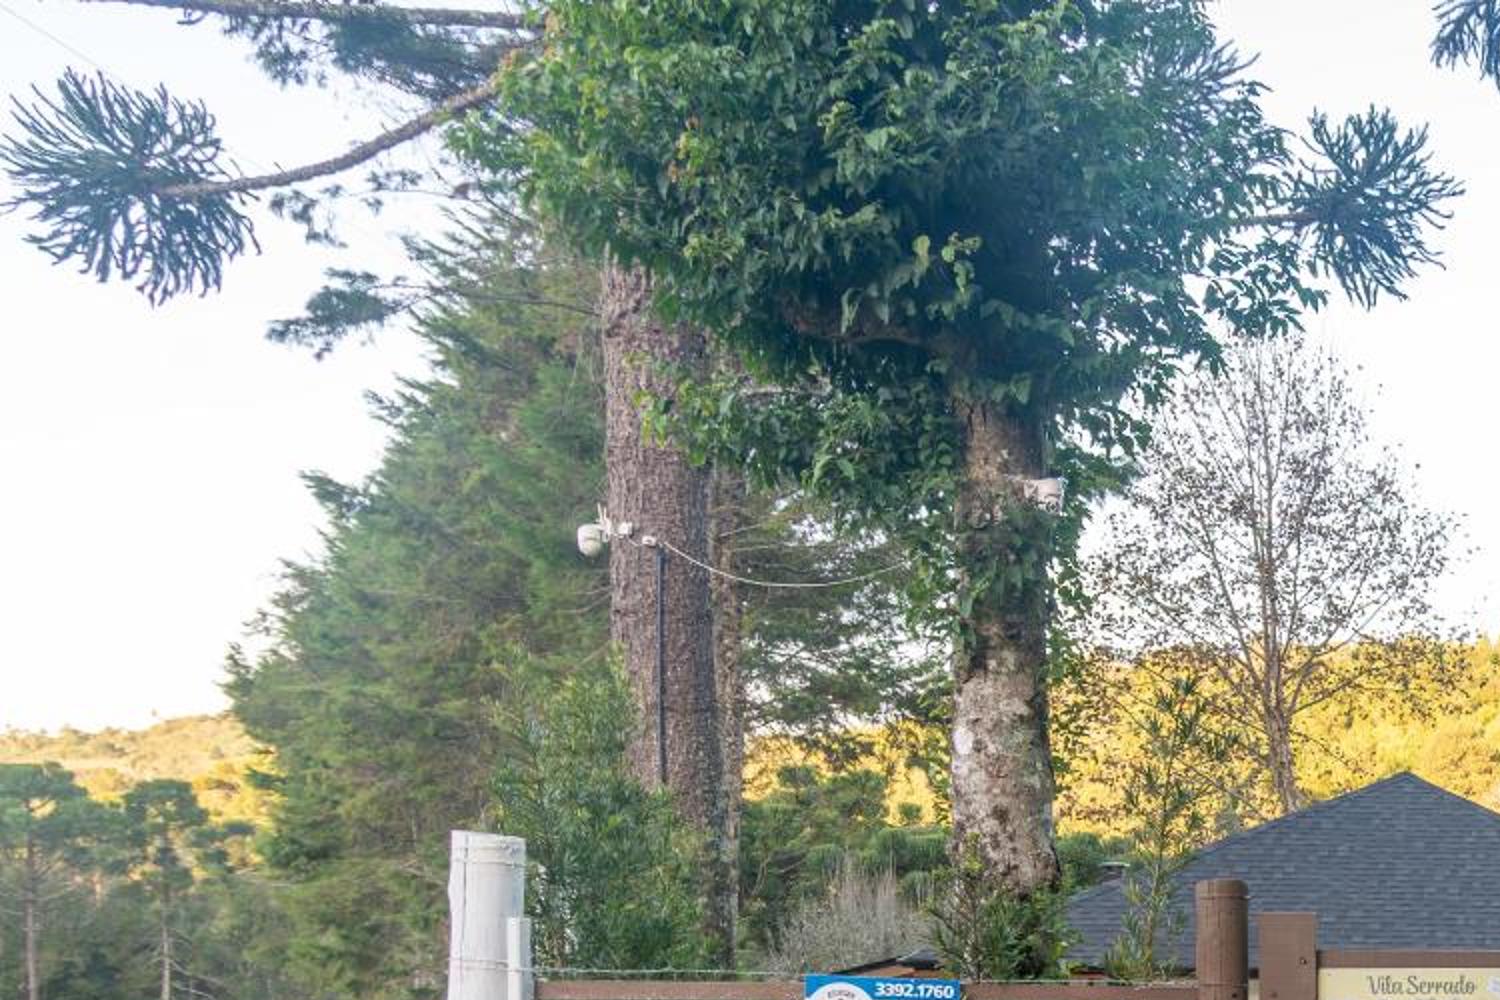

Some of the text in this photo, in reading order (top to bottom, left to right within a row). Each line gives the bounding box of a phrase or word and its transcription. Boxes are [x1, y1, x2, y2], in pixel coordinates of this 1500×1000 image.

[874, 981, 955, 999] 3392.1760
[1367, 975, 1404, 995] Vila
[1406, 974, 1476, 995] Serrado
